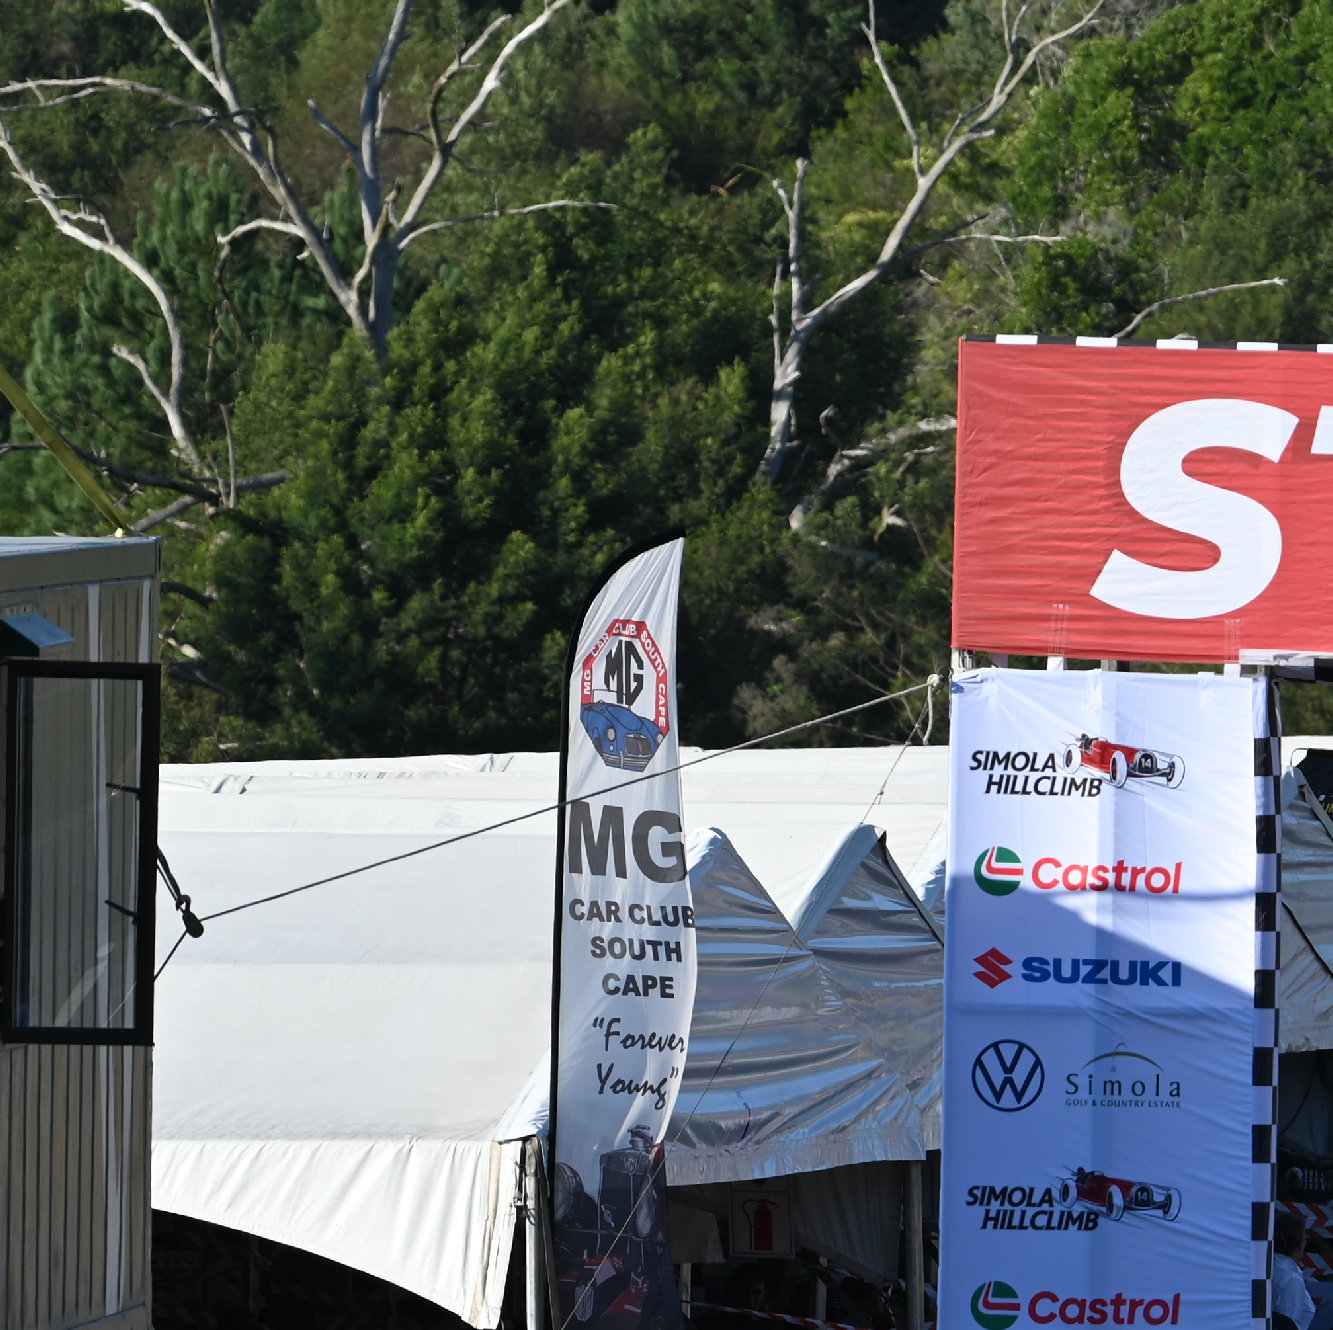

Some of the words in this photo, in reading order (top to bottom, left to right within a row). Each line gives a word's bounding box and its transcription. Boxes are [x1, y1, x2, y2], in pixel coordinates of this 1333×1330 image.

[641, 630, 666, 677] SOUTH
[604, 638, 643, 707] MG
[658, 683, 667, 728] CAPE
[969, 749, 1057, 774] SIMOLA
[1139, 755, 1154, 769] 14
[984, 774, 1102, 798] HILLCLIMB
[567, 801, 688, 883] MG
[1031, 856, 1183, 895] Castrol
[568, 898, 622, 923] CAR
[628, 903, 696, 929] CLUB
[590, 935, 683, 963] SOUTH
[601, 972, 675, 999] CAPE
[1021, 956, 1182, 988] SUZUKI
[1065, 1073, 1181, 1098] Simola
[1065, 1098, 1089, 1107] GOLF
[1091, 1099, 1098, 1108] &
[1099, 1099, 1145, 1109] COUNTRY
[1148, 1100, 1182, 1109] ESTATE
[965, 1185, 1054, 1206] SIMOLA
[981, 1209, 1099, 1231] HILLCLIMB
[1028, 1290, 1181, 1326] Castrol
